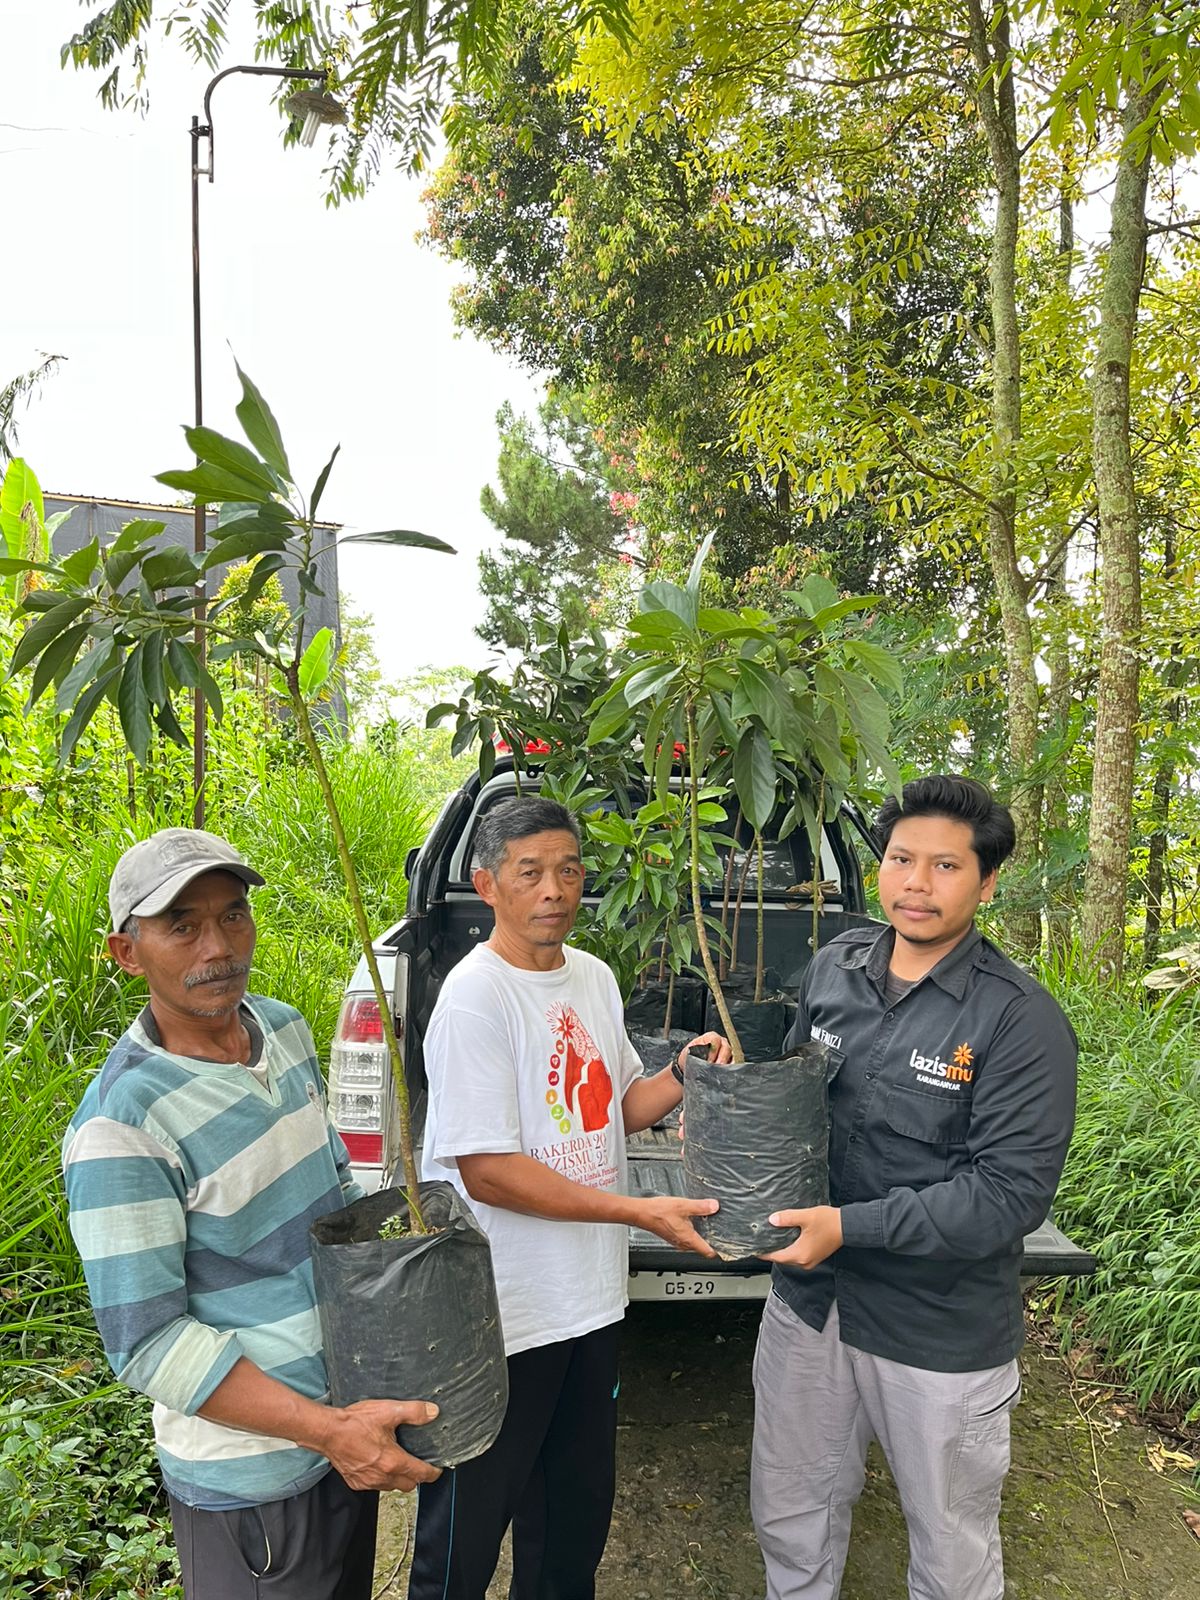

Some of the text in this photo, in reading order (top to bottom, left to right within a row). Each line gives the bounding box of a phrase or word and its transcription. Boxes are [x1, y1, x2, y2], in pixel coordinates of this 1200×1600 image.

[909, 1048, 974, 1082] lazismu
[916, 1074, 961, 1091] KARANGANYAR
[530, 1137, 592, 1160] RAKERDA
